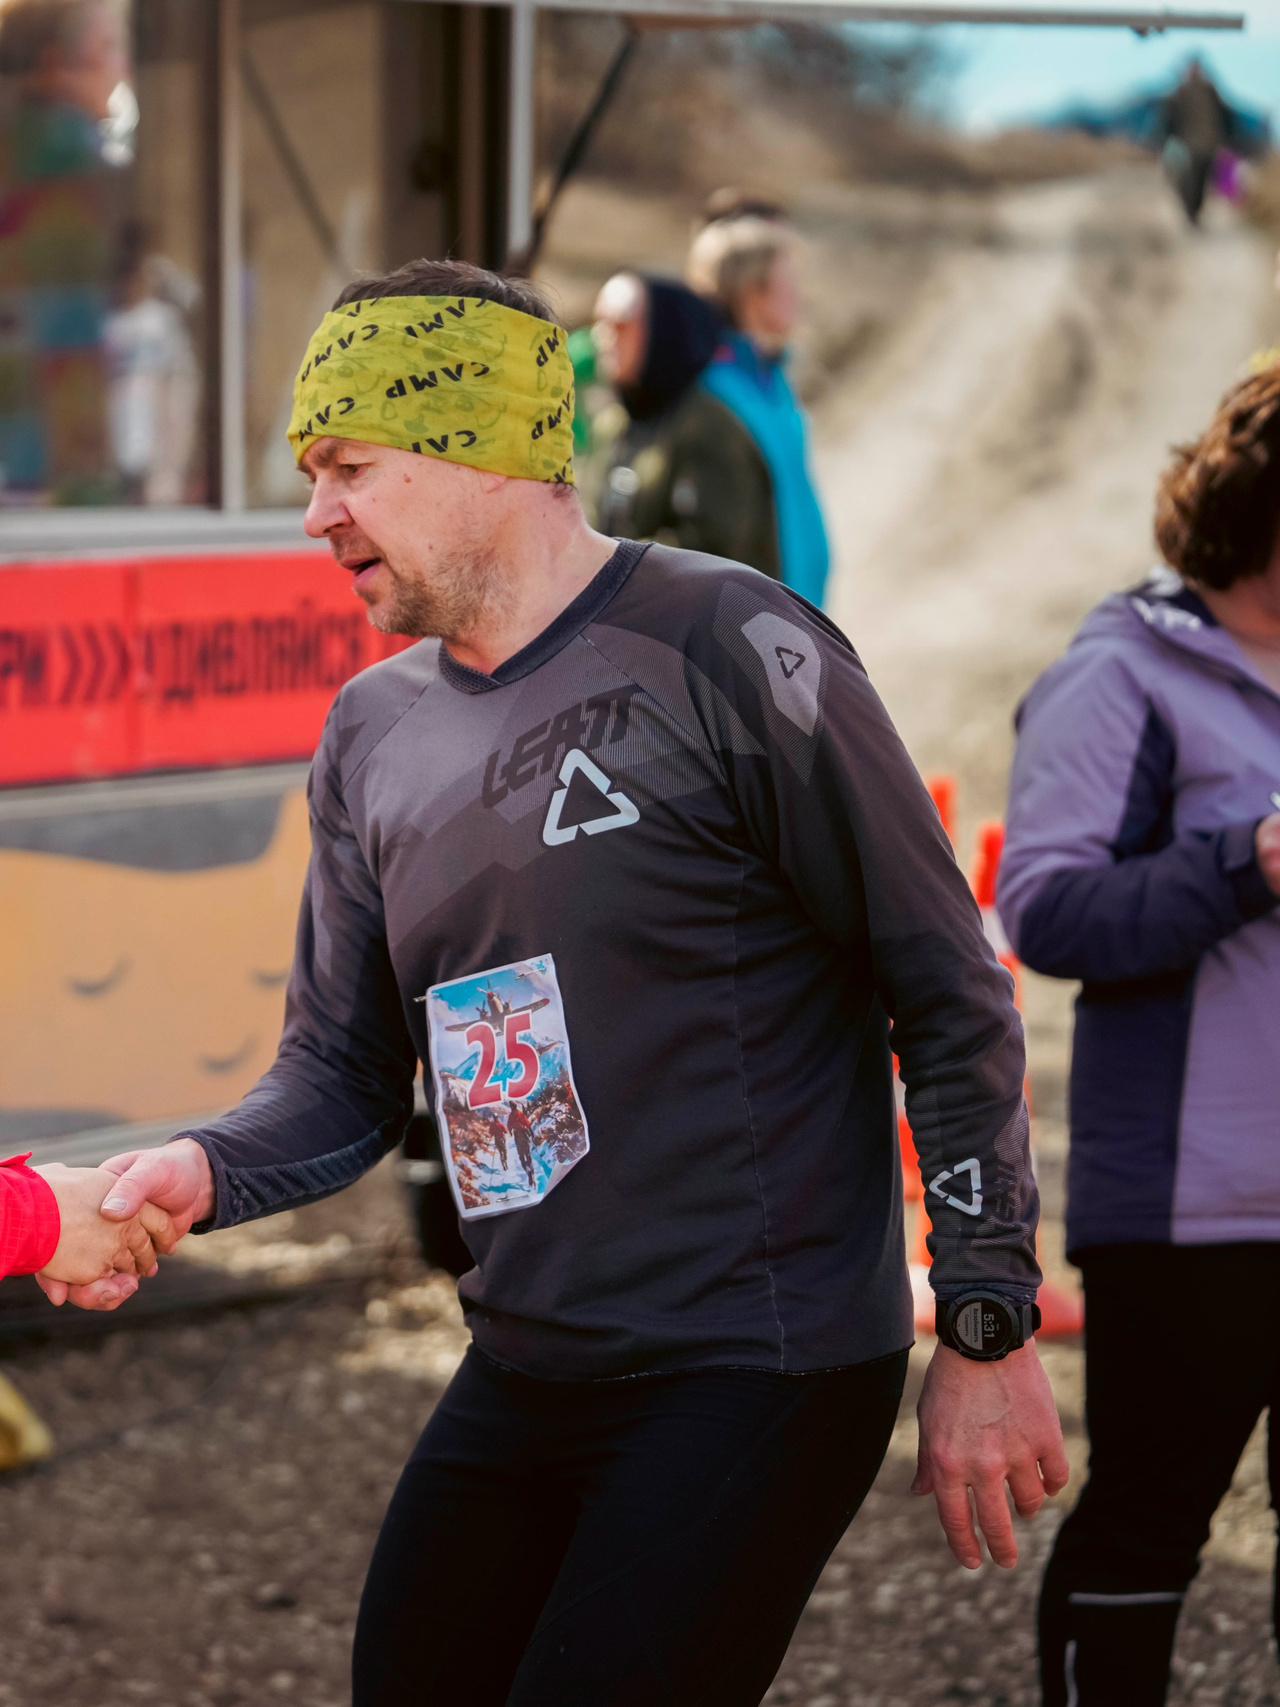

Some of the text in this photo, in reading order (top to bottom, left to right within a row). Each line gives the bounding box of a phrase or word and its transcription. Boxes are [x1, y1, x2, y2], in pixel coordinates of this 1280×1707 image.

[386, 361, 490, 399] CAMP
[298, 396, 356, 443] CAM
[482, 684, 646, 809] LEATT
[466, 1010, 539, 1110] 25
[983, 1313, 995, 1338] 5:31
